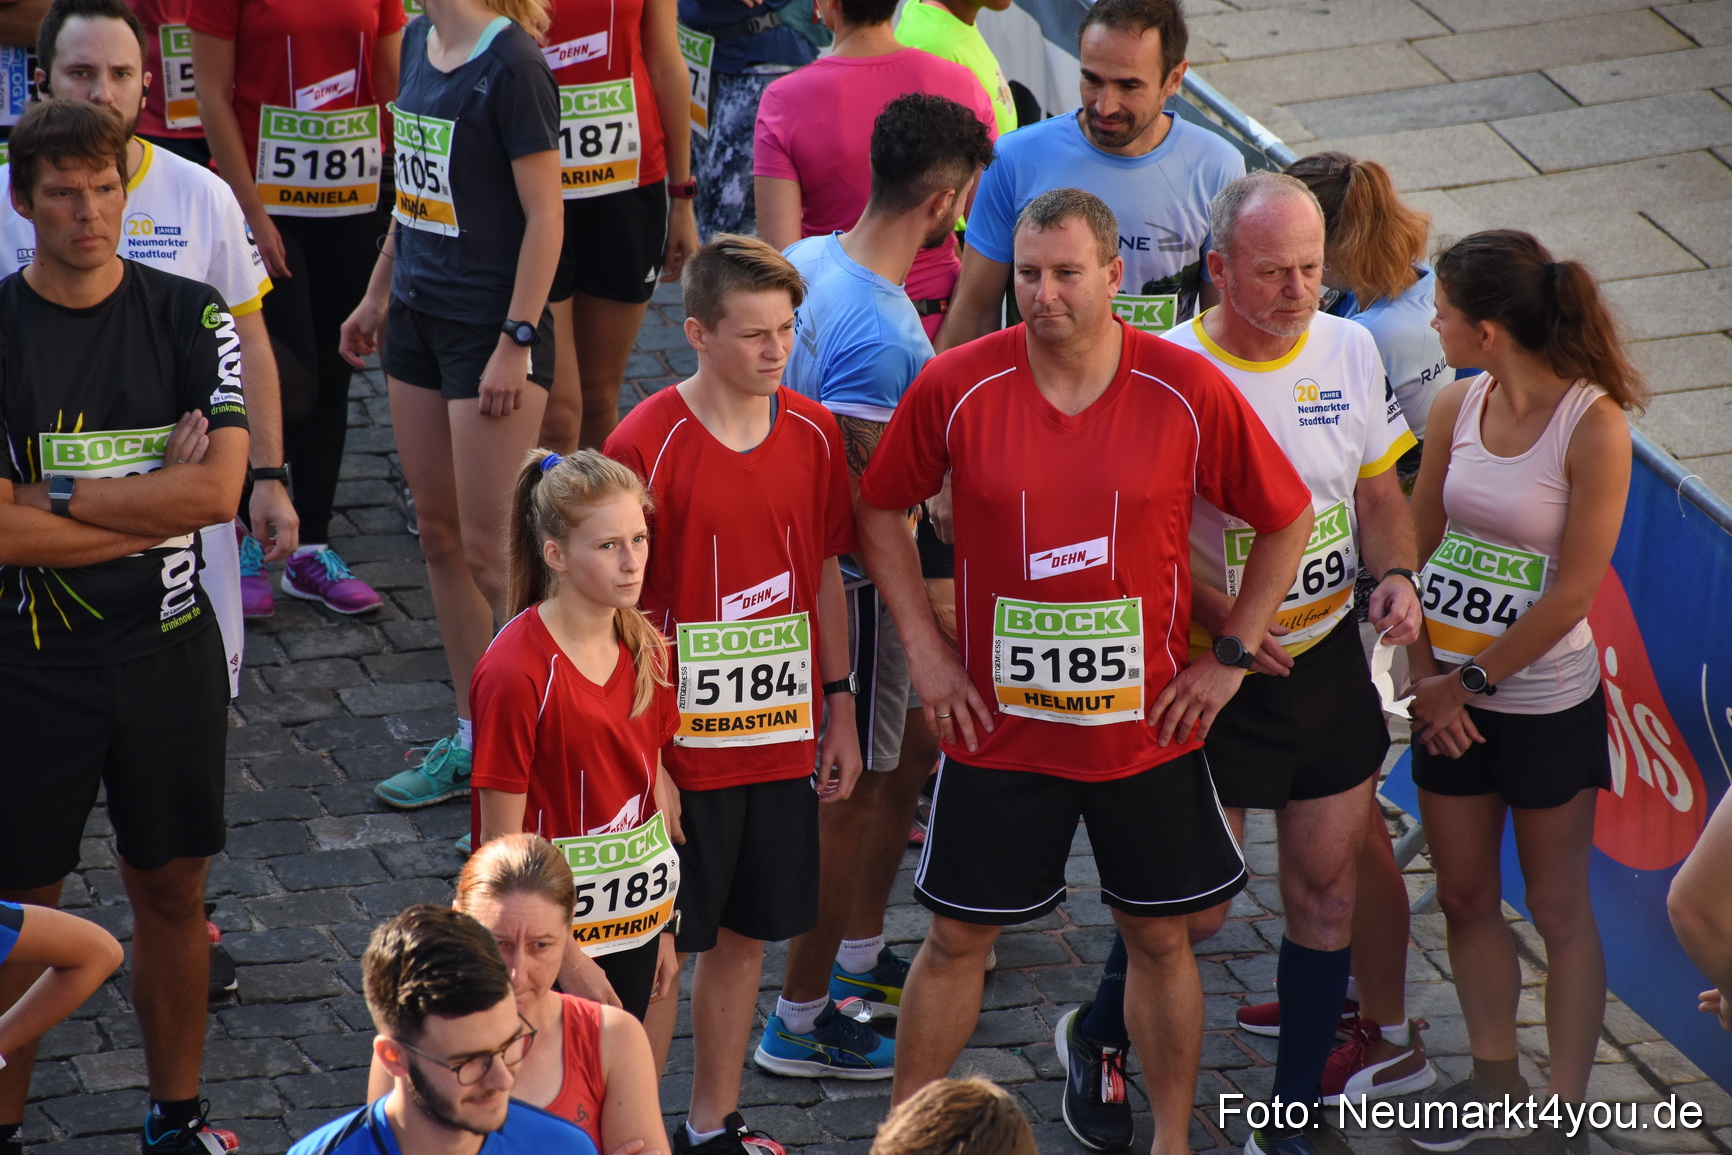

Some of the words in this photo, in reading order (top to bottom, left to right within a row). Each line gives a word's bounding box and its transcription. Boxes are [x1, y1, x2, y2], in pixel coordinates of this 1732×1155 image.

[559, 44, 589, 61] DEHN
[314, 82, 340, 100] DEHN
[560, 86, 626, 114] OCK
[272, 113, 368, 138] BOCK
[395, 115, 441, 150] OCK
[559, 121, 623, 160] 187
[273, 146, 365, 180] 5181
[394, 152, 440, 194] 105
[561, 166, 616, 186] ARINA
[279, 189, 359, 204] DANIELA
[127, 219, 153, 236] 20
[157, 227, 180, 235] JAHRE
[128, 238, 189, 248] Neumarkter
[128, 250, 178, 261] Stadtlauf
[1296, 384, 1319, 402] 20
[1321, 392, 1341, 400] JAHRE
[1298, 403, 1350, 414] Neumarkter
[1300, 415, 1341, 427] Stadtlauf
[55, 433, 170, 464] BOCK
[1051, 550, 1087, 569] DEHN
[1437, 540, 1527, 582] BOCK
[1283, 550, 1345, 602] 69
[742, 587, 773, 610] DEHN
[1423, 573, 1518, 629] 5284
[161, 606, 201, 632] drinknow.de
[1006, 606, 1128, 634] BOCK
[691, 621, 799, 655] BOCK
[1010, 645, 1126, 684] 5185
[695, 661, 797, 706] 5184
[1024, 692, 1116, 711] HELMUT
[691, 709, 798, 732] SEBASTIAN
[568, 823, 661, 870] BOCK
[575, 862, 668, 918] 5183
[573, 911, 660, 943] KATHRIN
